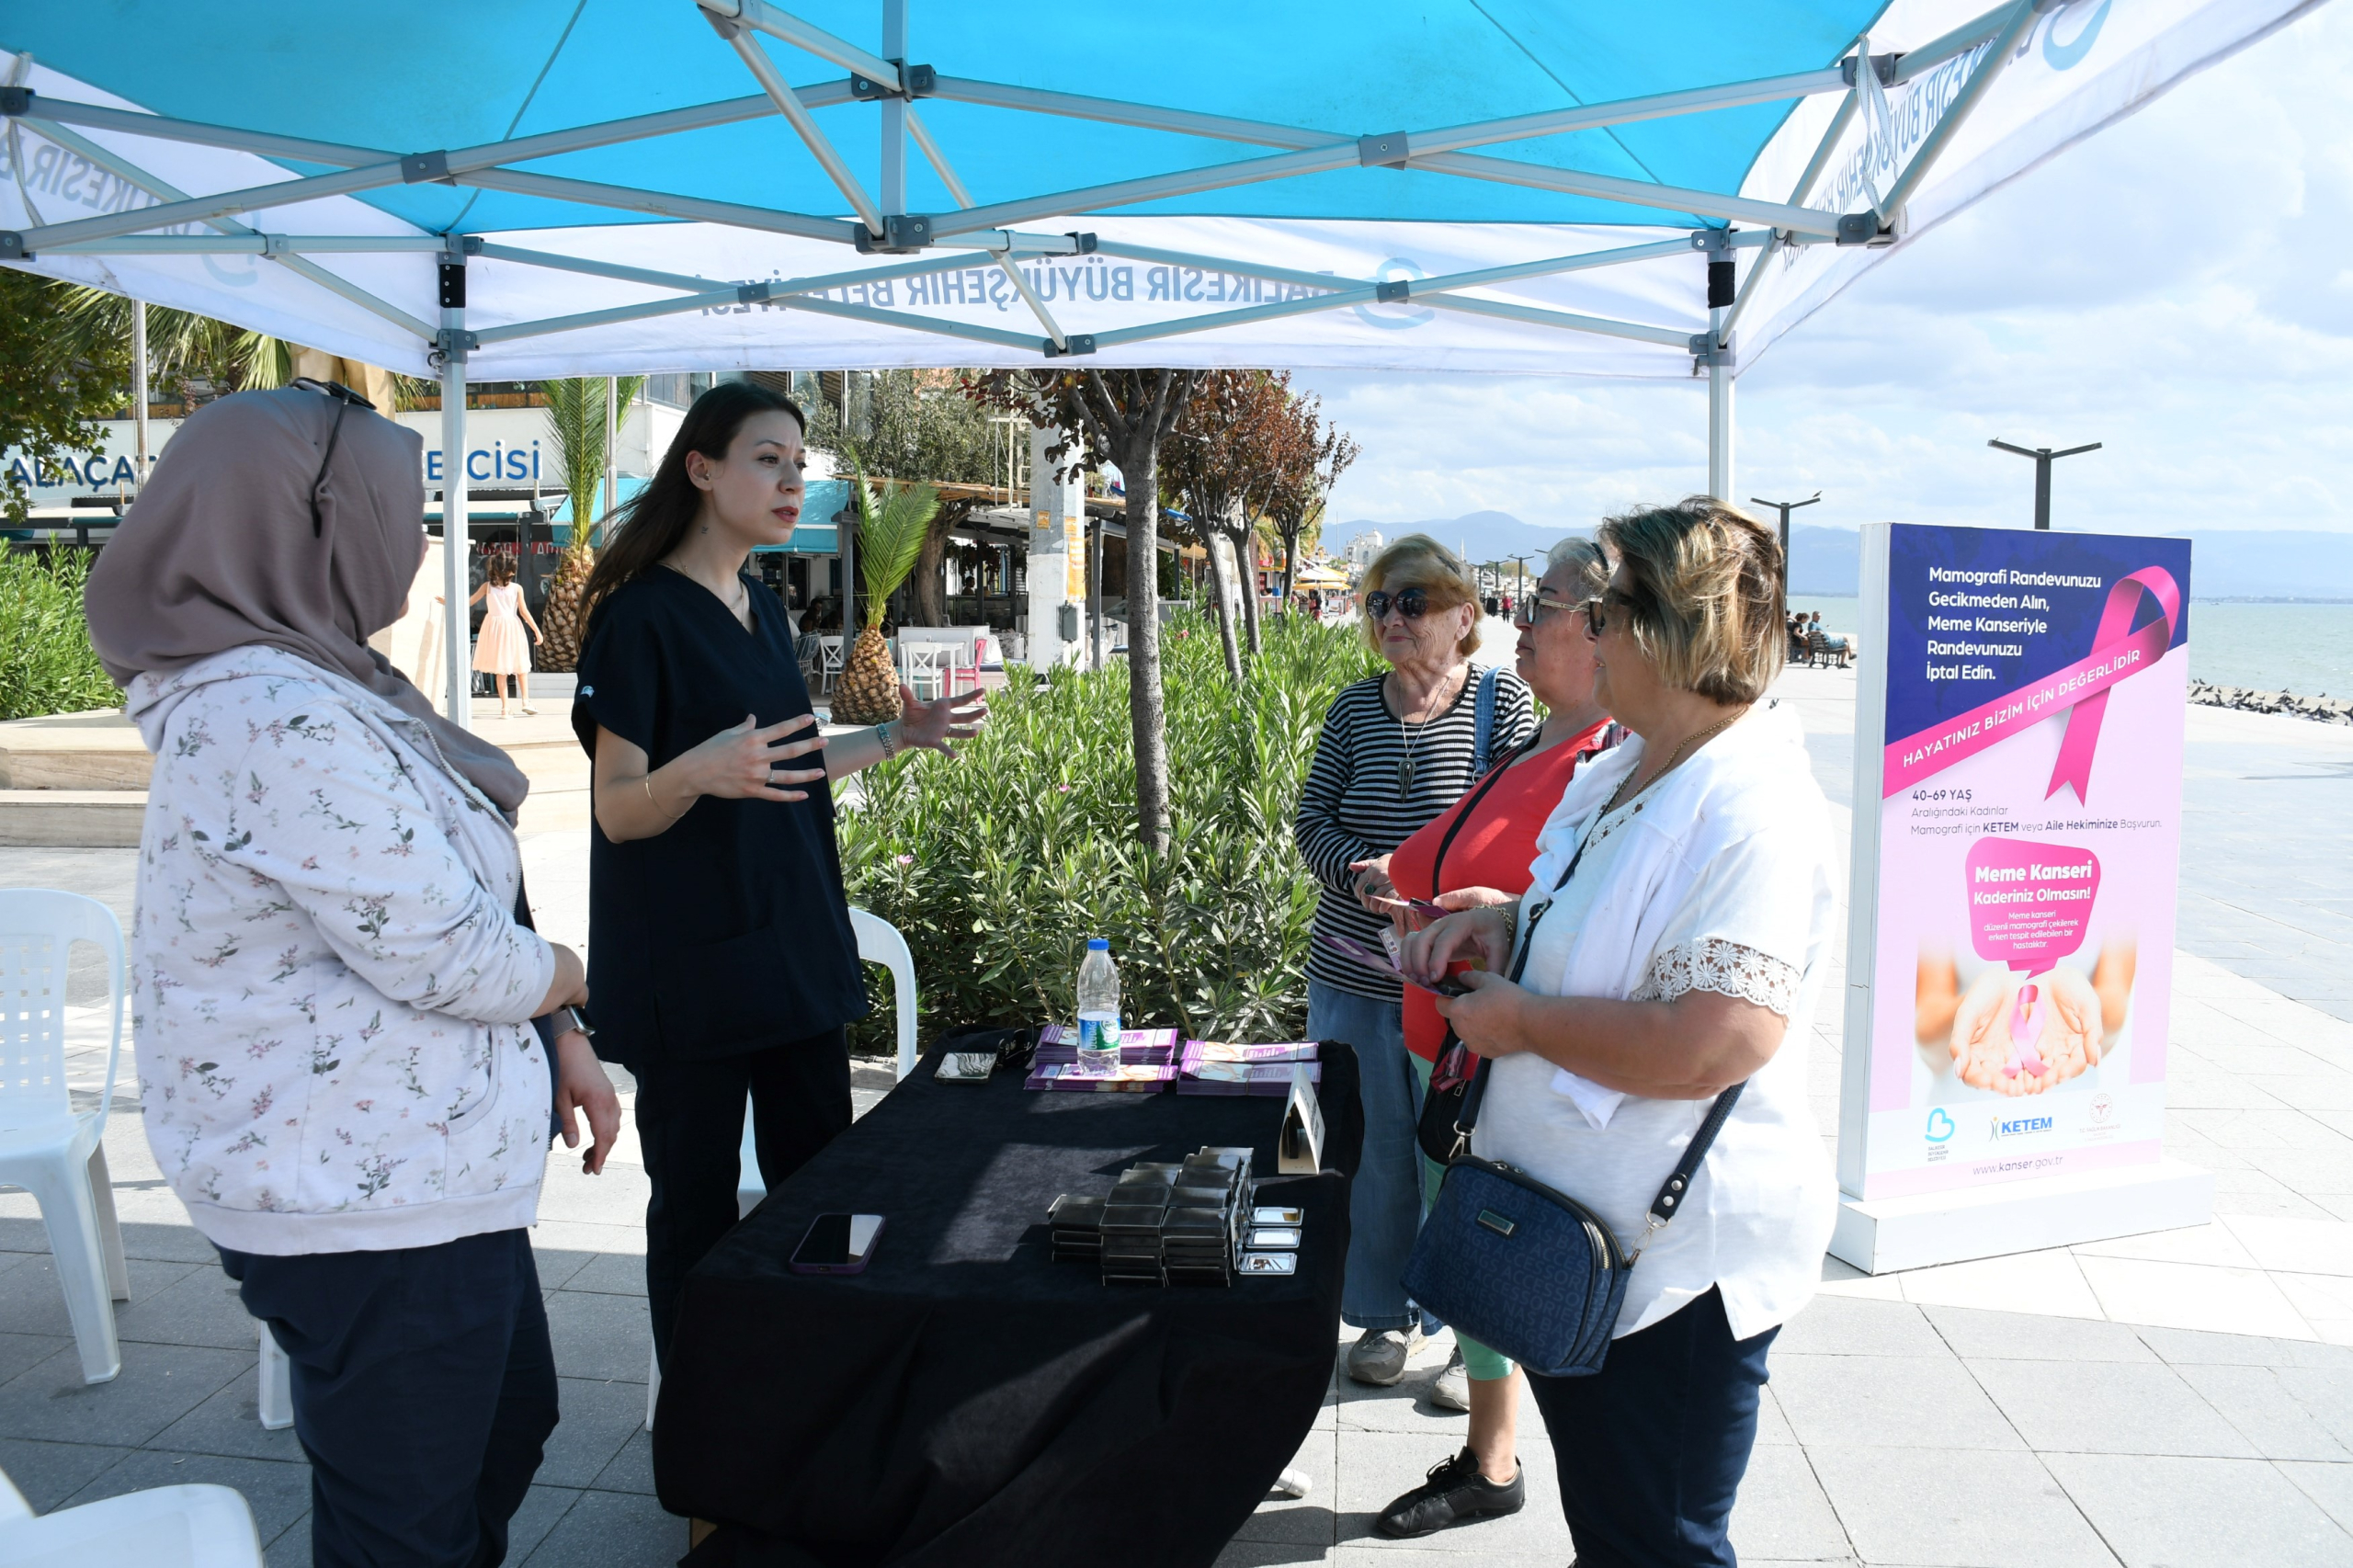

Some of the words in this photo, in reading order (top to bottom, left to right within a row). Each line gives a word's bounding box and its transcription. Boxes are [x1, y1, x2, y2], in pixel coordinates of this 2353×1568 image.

[1929, 567, 2007, 586] Mamografi
[2010, 570, 2102, 588] Randevunuzu
[1928, 591, 2018, 608] Gecikmeden
[2020, 595, 2051, 612] Alın,
[1927, 616, 1972, 631] Meme
[1975, 617, 2048, 636] Kanseriyle
[1927, 640, 2023, 656] Randevunuzu
[1926, 661, 1959, 682] İptal
[1961, 665, 1996, 680] Edin.
[1903, 722, 1981, 767] HAYATINIZ
[1984, 702, 2023, 731] BİZİM
[2027, 688, 2055, 710] İÇİN
[2058, 649, 2141, 697] DEĞERLİDİR
[1912, 790, 1947, 801] 40-69
[1949, 789, 1972, 802] YAŞ
[1911, 805, 1968, 818] Aralığındaki
[1970, 806, 2008, 816] Kadınlar
[1911, 824, 1963, 836] Mamografi
[1965, 824, 1981, 835] için
[1983, 821, 2019, 834] KETEM
[2021, 823, 2043, 833] veya
[2045, 820, 2064, 832] Aile
[2066, 818, 2119, 830] Hekiminize
[1974, 866, 2027, 883] Meme
[2029, 859, 2093, 881] Kanseri
[1973, 888, 2034, 904] Kaderiniz
[2036, 886, 2091, 902] Olmasın!
[2008, 912, 2030, 920] Meme
[2031, 910, 2056, 919] kanseri
[1984, 922, 2008, 932] düzenli
[2009, 920, 2048, 931] mamografi
[1988, 932, 2009, 941] erken
[2009, 931, 2029, 940] tespit
[2063, 928, 2074, 937] bir
[2001, 1116, 2052, 1133] KETEM
[1972, 1156, 2063, 1175] www.kanser.gov.tr
